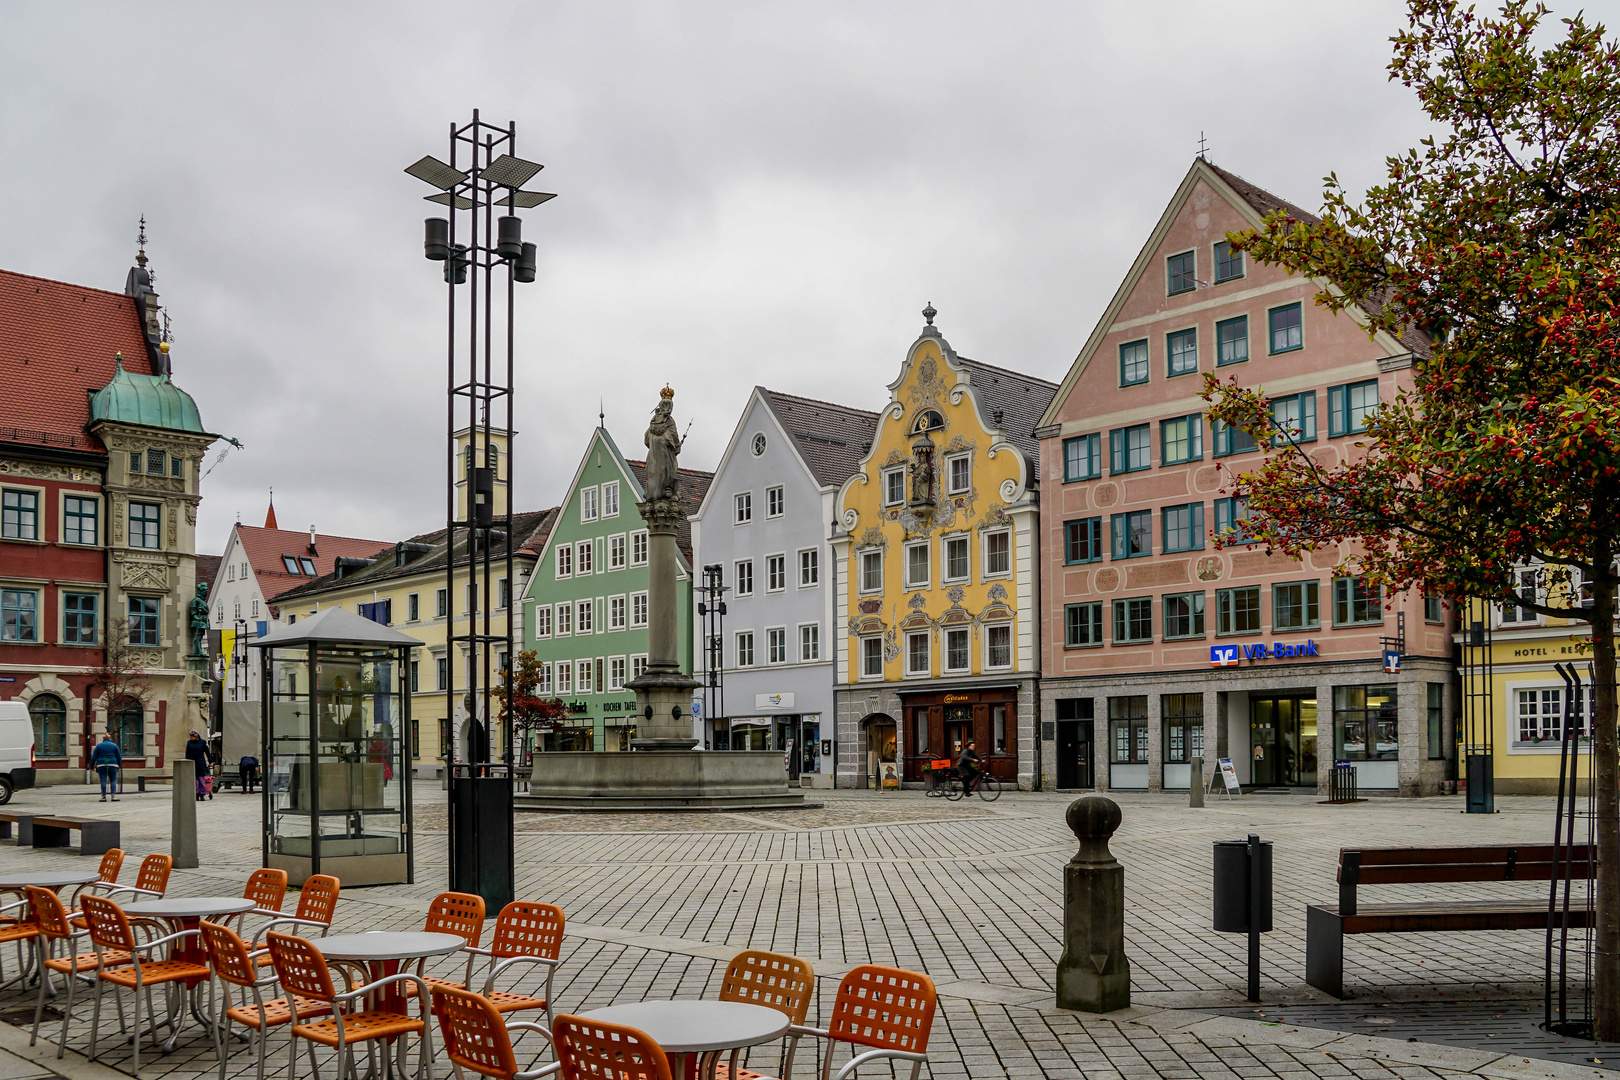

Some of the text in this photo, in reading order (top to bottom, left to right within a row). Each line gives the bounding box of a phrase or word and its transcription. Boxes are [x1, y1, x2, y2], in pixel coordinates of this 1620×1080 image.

[1243, 639, 1319, 659] VR-Bank
[1514, 648, 1547, 657] HOTEL
[603, 702, 621, 711] KOCHEN
